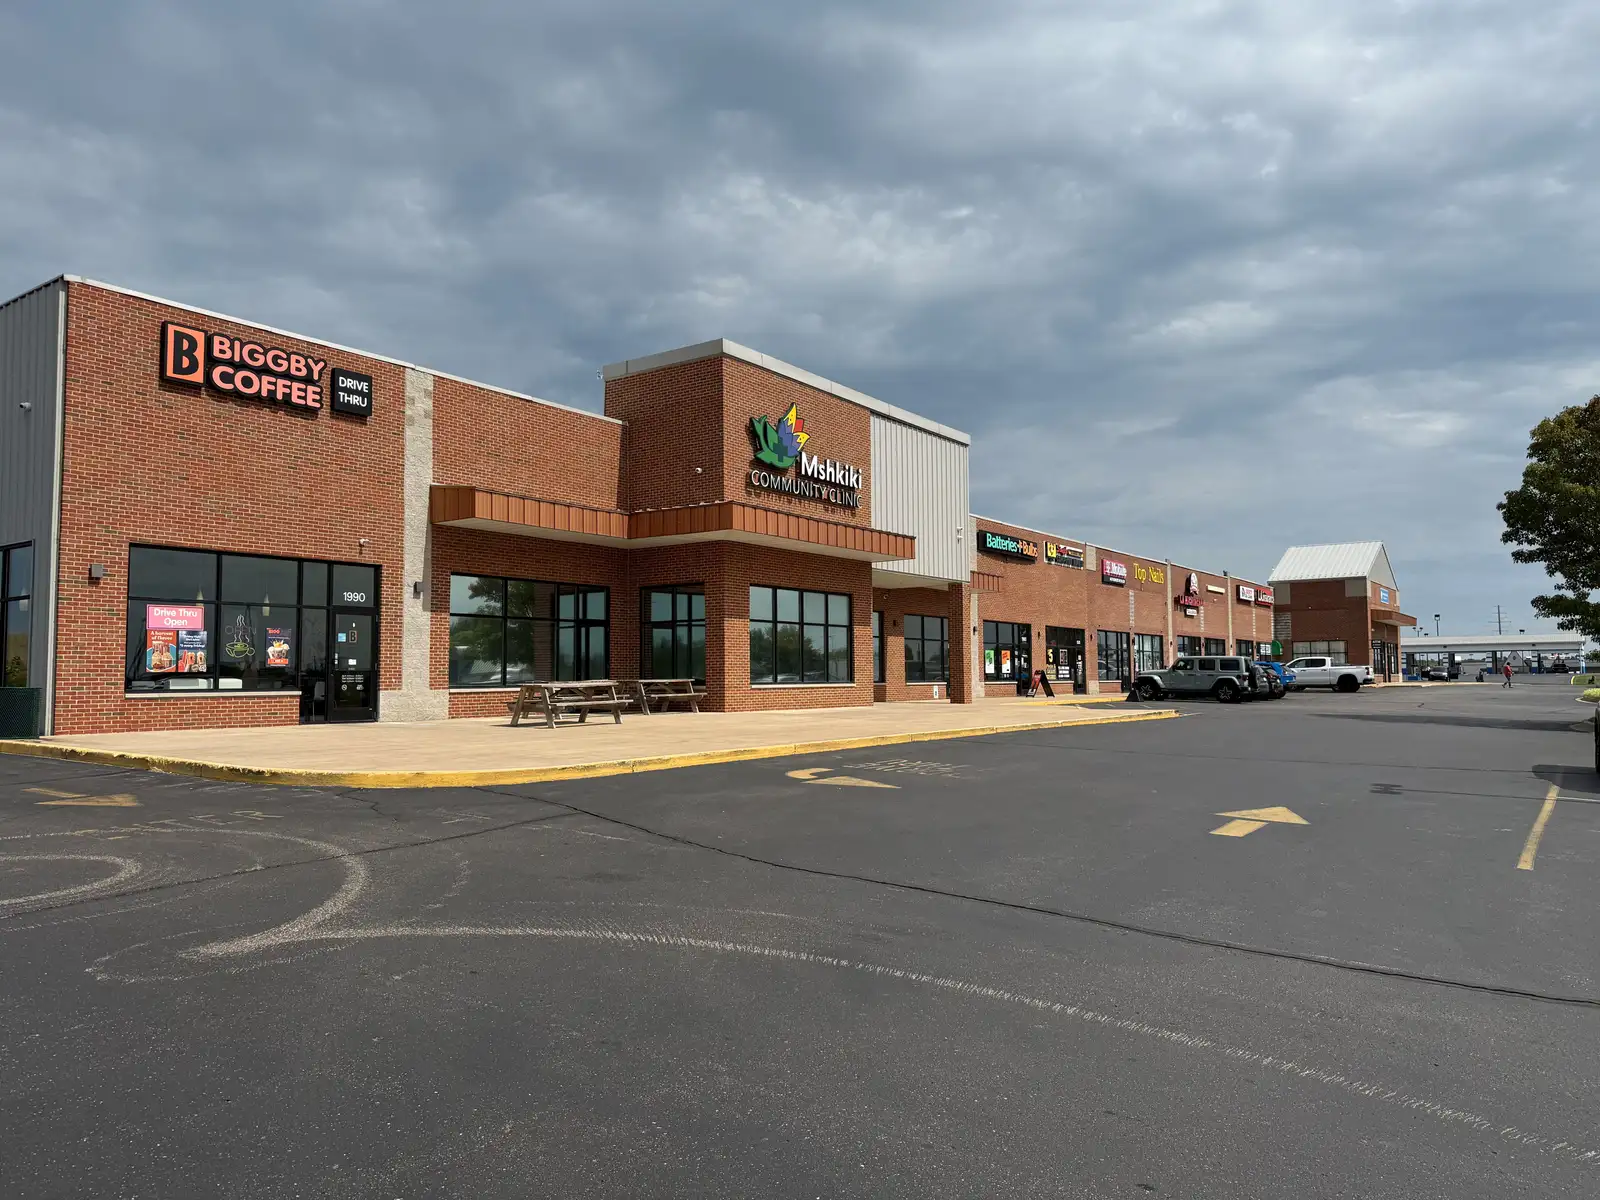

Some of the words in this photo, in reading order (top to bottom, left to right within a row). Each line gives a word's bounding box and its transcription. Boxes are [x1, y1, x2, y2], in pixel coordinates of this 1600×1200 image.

[172, 330, 199, 376] B
[212, 335, 325, 381] BIGGBY
[212, 365, 321, 408] COFFEE
[338, 376, 369, 393] DRIVE
[338, 391, 368, 408] THRU
[801, 451, 862, 489] Mshkiki
[751, 470, 828, 499] COMMUNITY
[829, 488, 862, 509] CLINIC
[1133, 562, 1147, 583] Top
[1149, 565, 1164, 584] Nails
[343, 591, 366, 603] 1990
[153, 608, 177, 617] Drive
[178, 608, 198, 618] Thru
[164, 618, 188, 627] Open
[224, 625, 257, 636] OPEN
